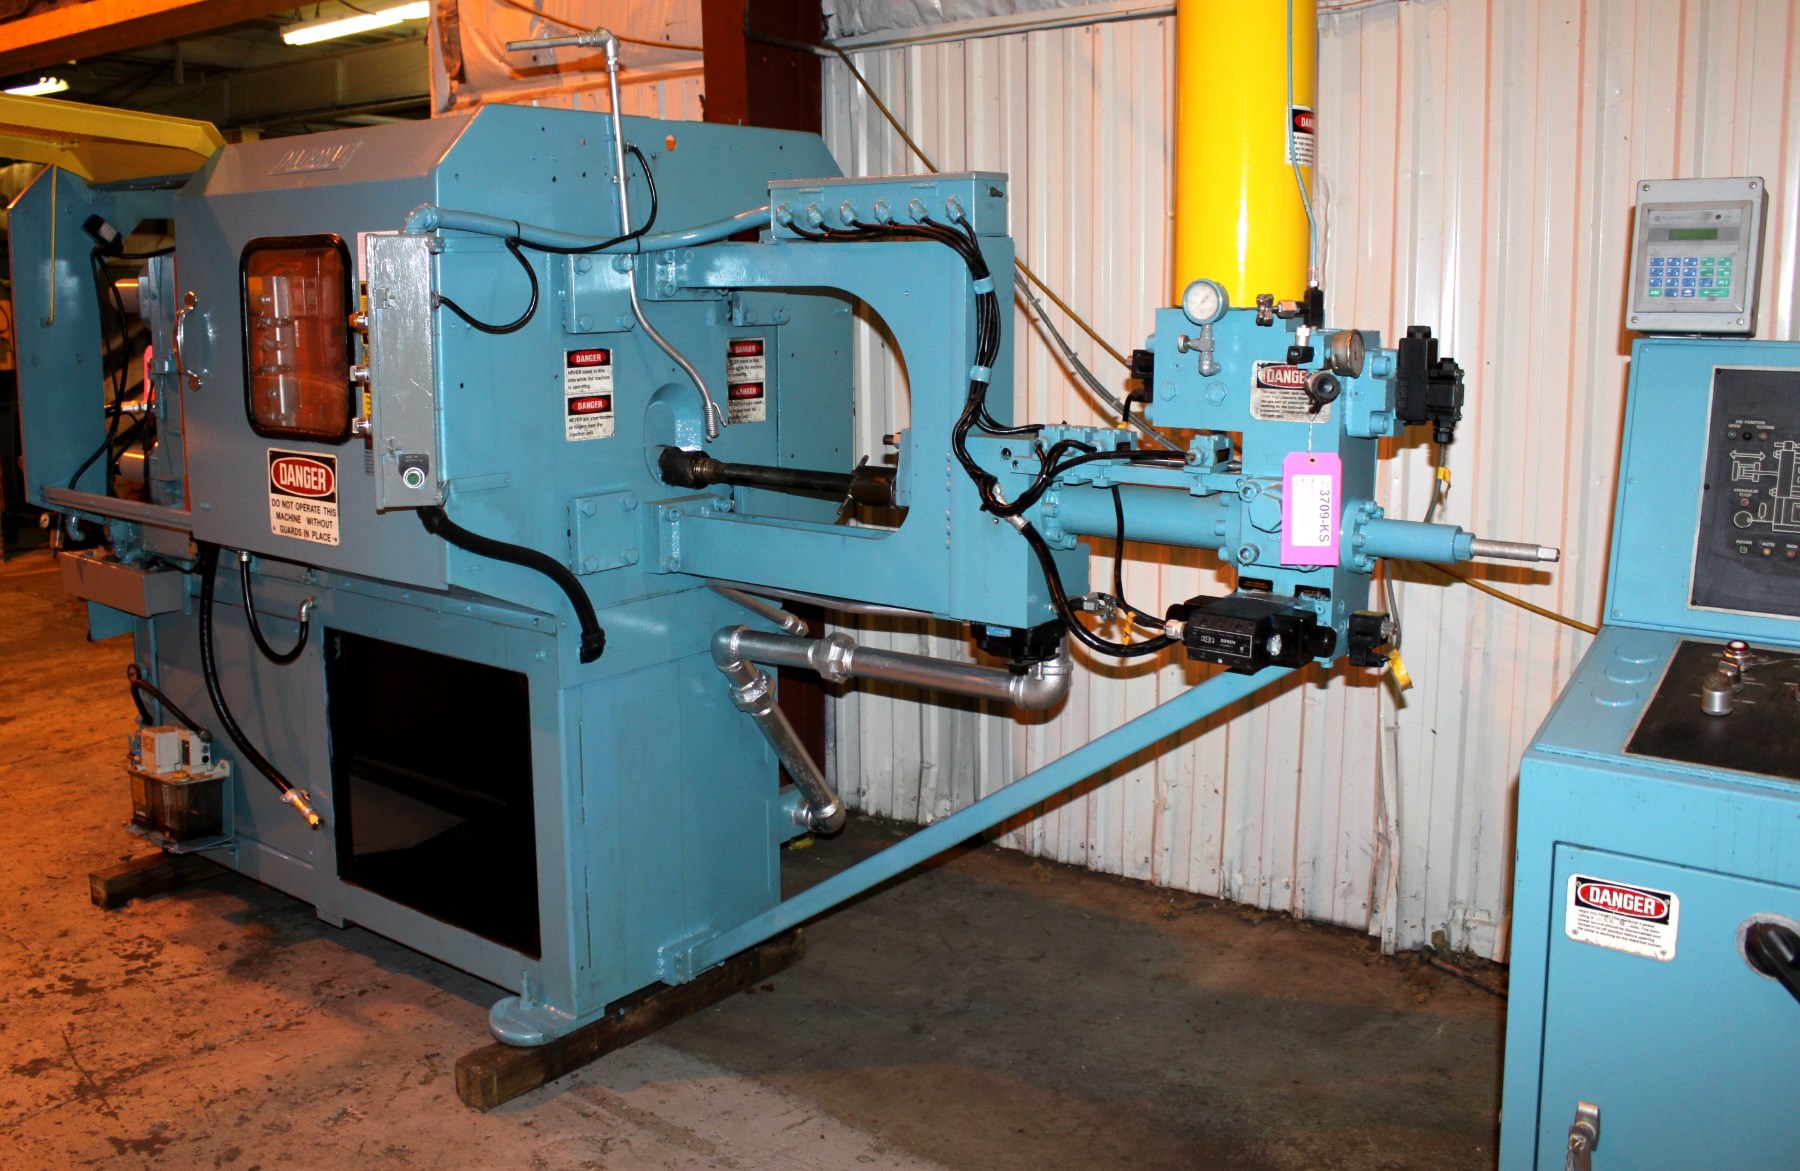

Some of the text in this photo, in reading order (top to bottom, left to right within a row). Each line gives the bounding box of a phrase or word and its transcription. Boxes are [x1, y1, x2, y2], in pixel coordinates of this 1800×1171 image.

[576, 354, 601, 363] DANGER
[1266, 369, 1306, 384] DANGE
[578, 401, 602, 410] DANGER
[280, 463, 326, 491] DANGER
[272, 499, 336, 516] DO NOT OPERATE THIS
[1319, 490, 1329, 542] 3709-KS
[276, 512, 332, 529] MACHINE WITHOUT
[280, 525, 331, 542] GUARDS IN PLACE
[1589, 887, 1655, 915] DANGER
